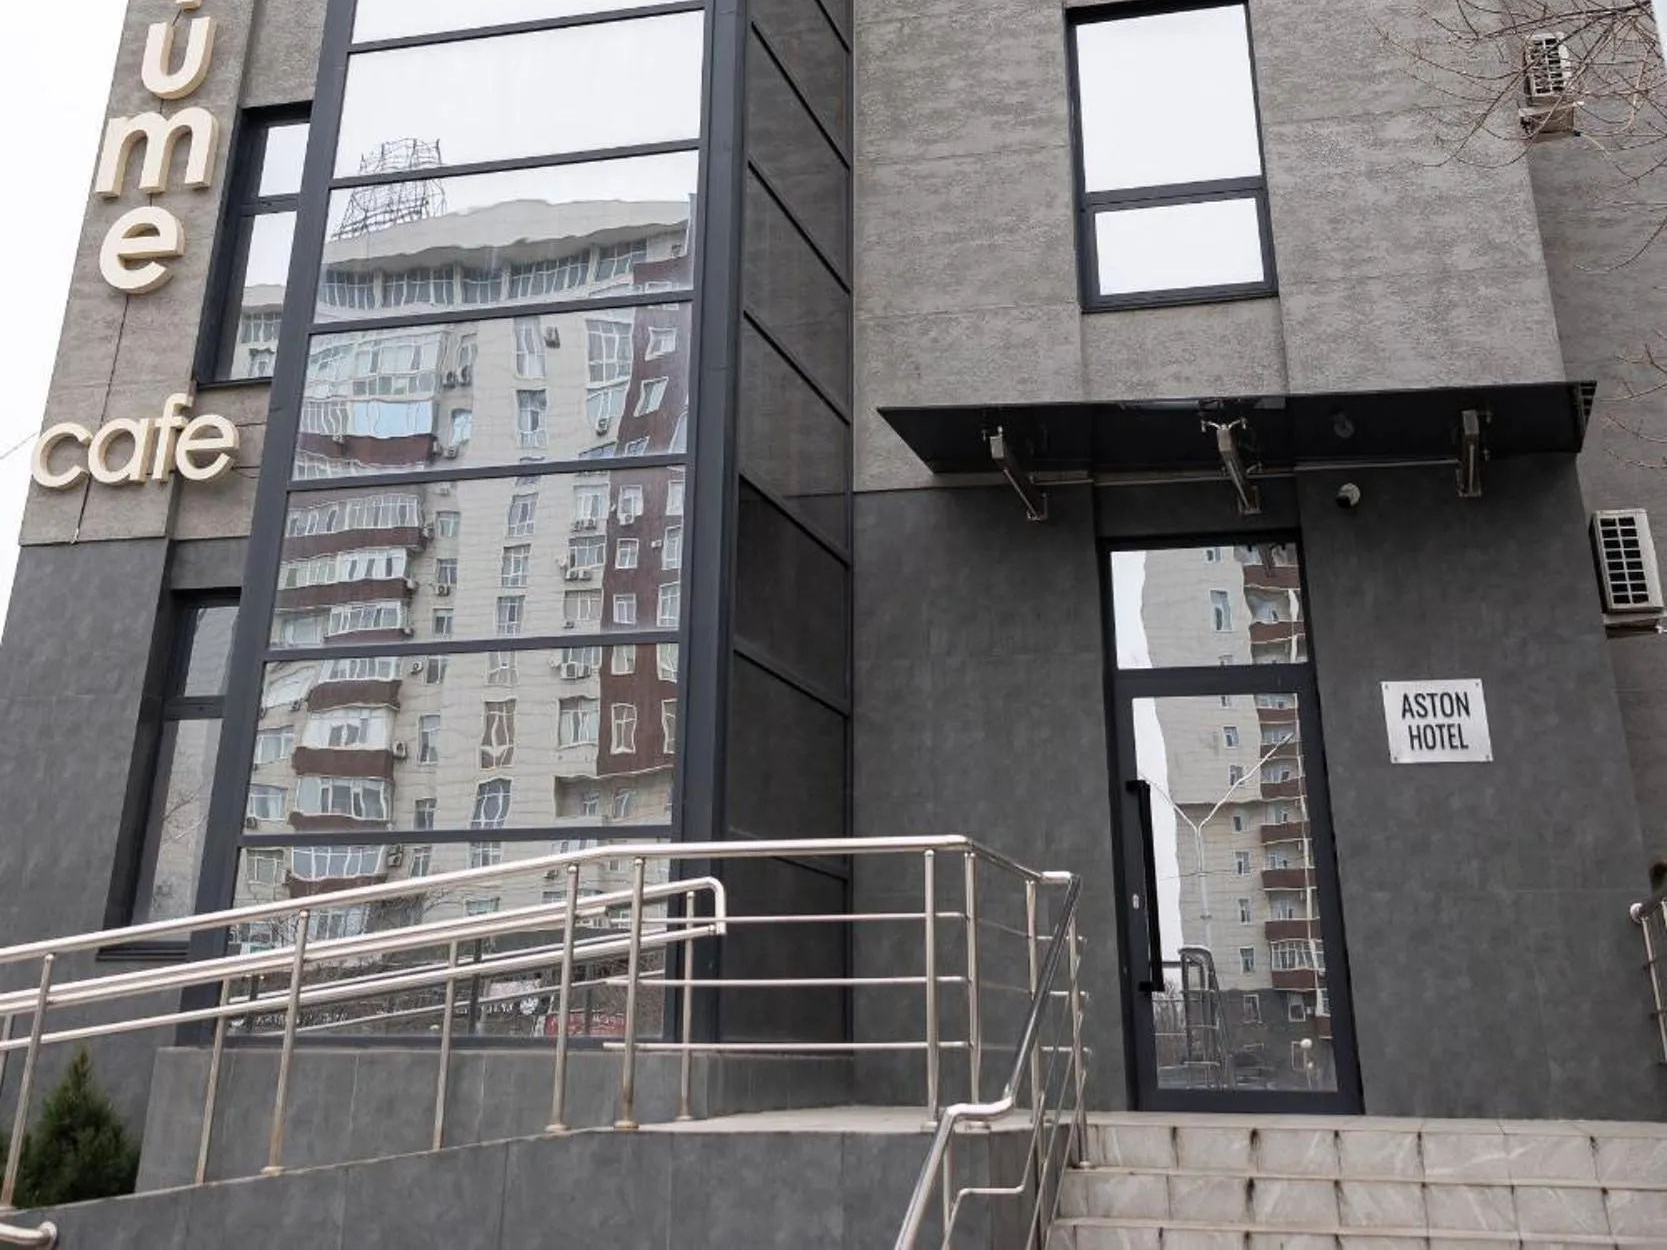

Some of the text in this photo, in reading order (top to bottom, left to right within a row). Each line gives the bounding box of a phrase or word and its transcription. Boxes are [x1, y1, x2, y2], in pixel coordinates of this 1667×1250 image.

[31, 393, 240, 489] cafe
[1402, 691, 1470, 719] ASTON
[1408, 723, 1469, 750] HOTEL
